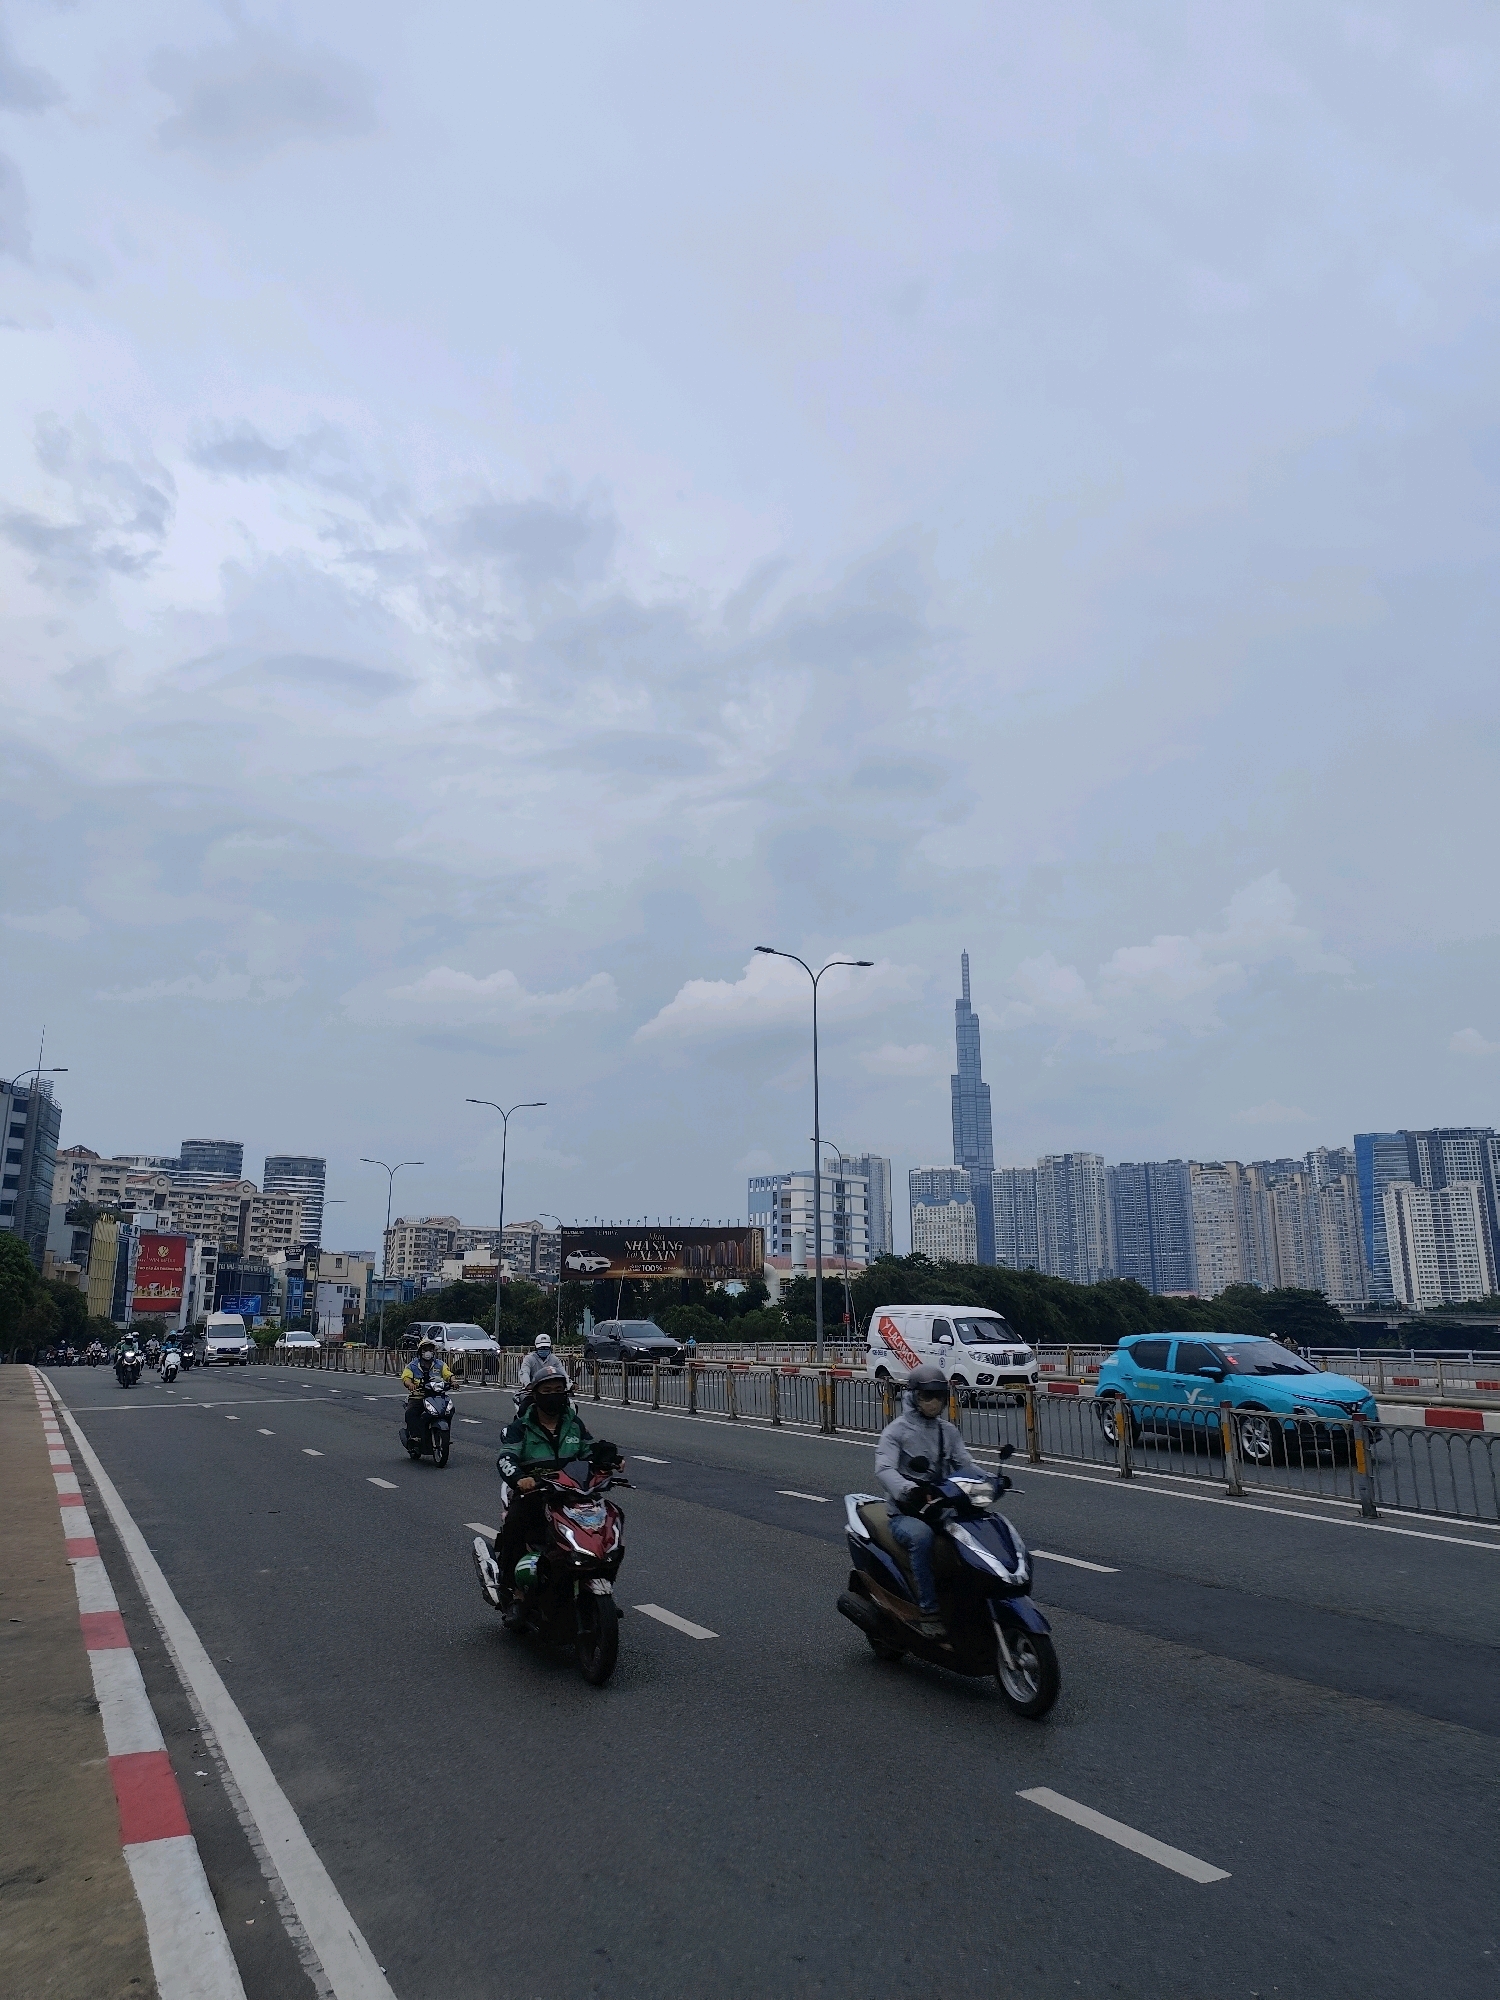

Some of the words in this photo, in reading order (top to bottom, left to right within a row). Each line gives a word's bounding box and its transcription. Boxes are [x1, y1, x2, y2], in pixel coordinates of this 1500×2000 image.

[652, 1240, 683, 1251] SANG
[642, 1264, 662, 1272] 100%
[888, 1326, 919, 1368] LALAMOV
[565, 1435, 580, 1444] Grab
